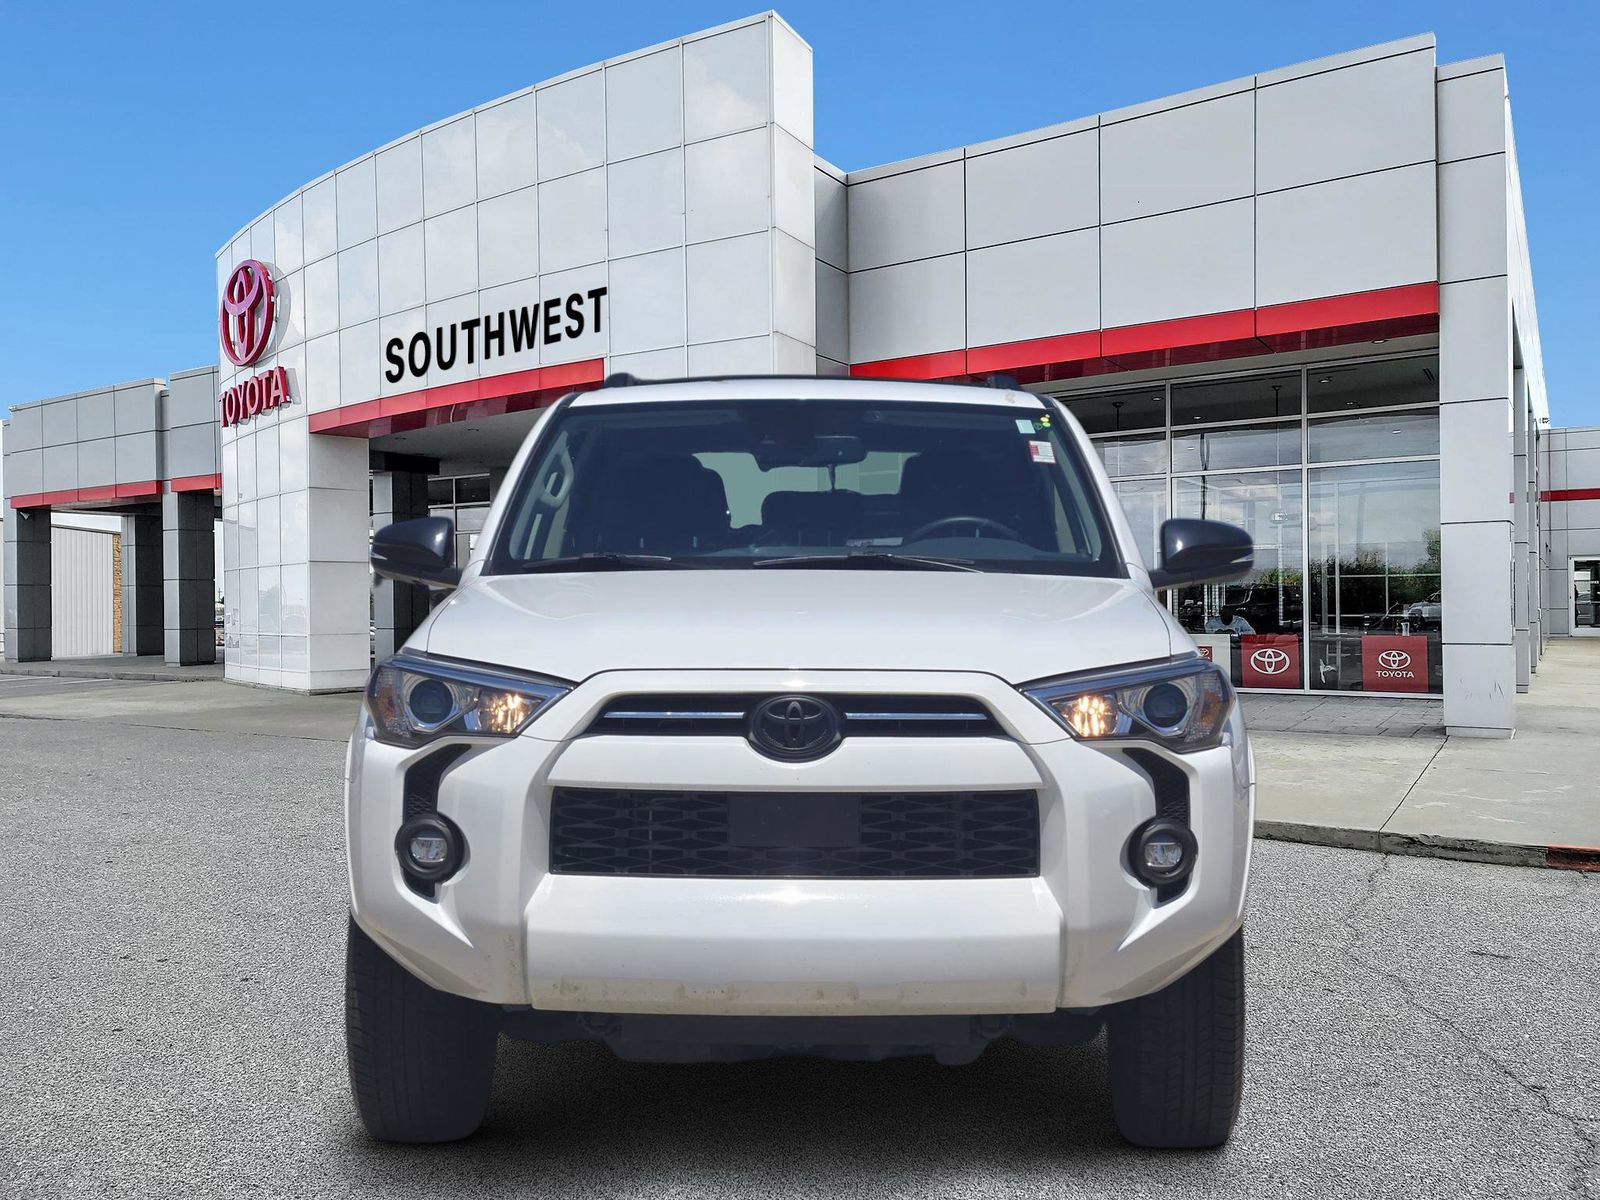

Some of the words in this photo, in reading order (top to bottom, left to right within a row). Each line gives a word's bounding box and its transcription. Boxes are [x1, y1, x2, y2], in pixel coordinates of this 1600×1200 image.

[385, 287, 608, 384] SOUTHWEST
[218, 366, 291, 428] TOYOTA
[1376, 670, 1415, 678] TOYOTA
